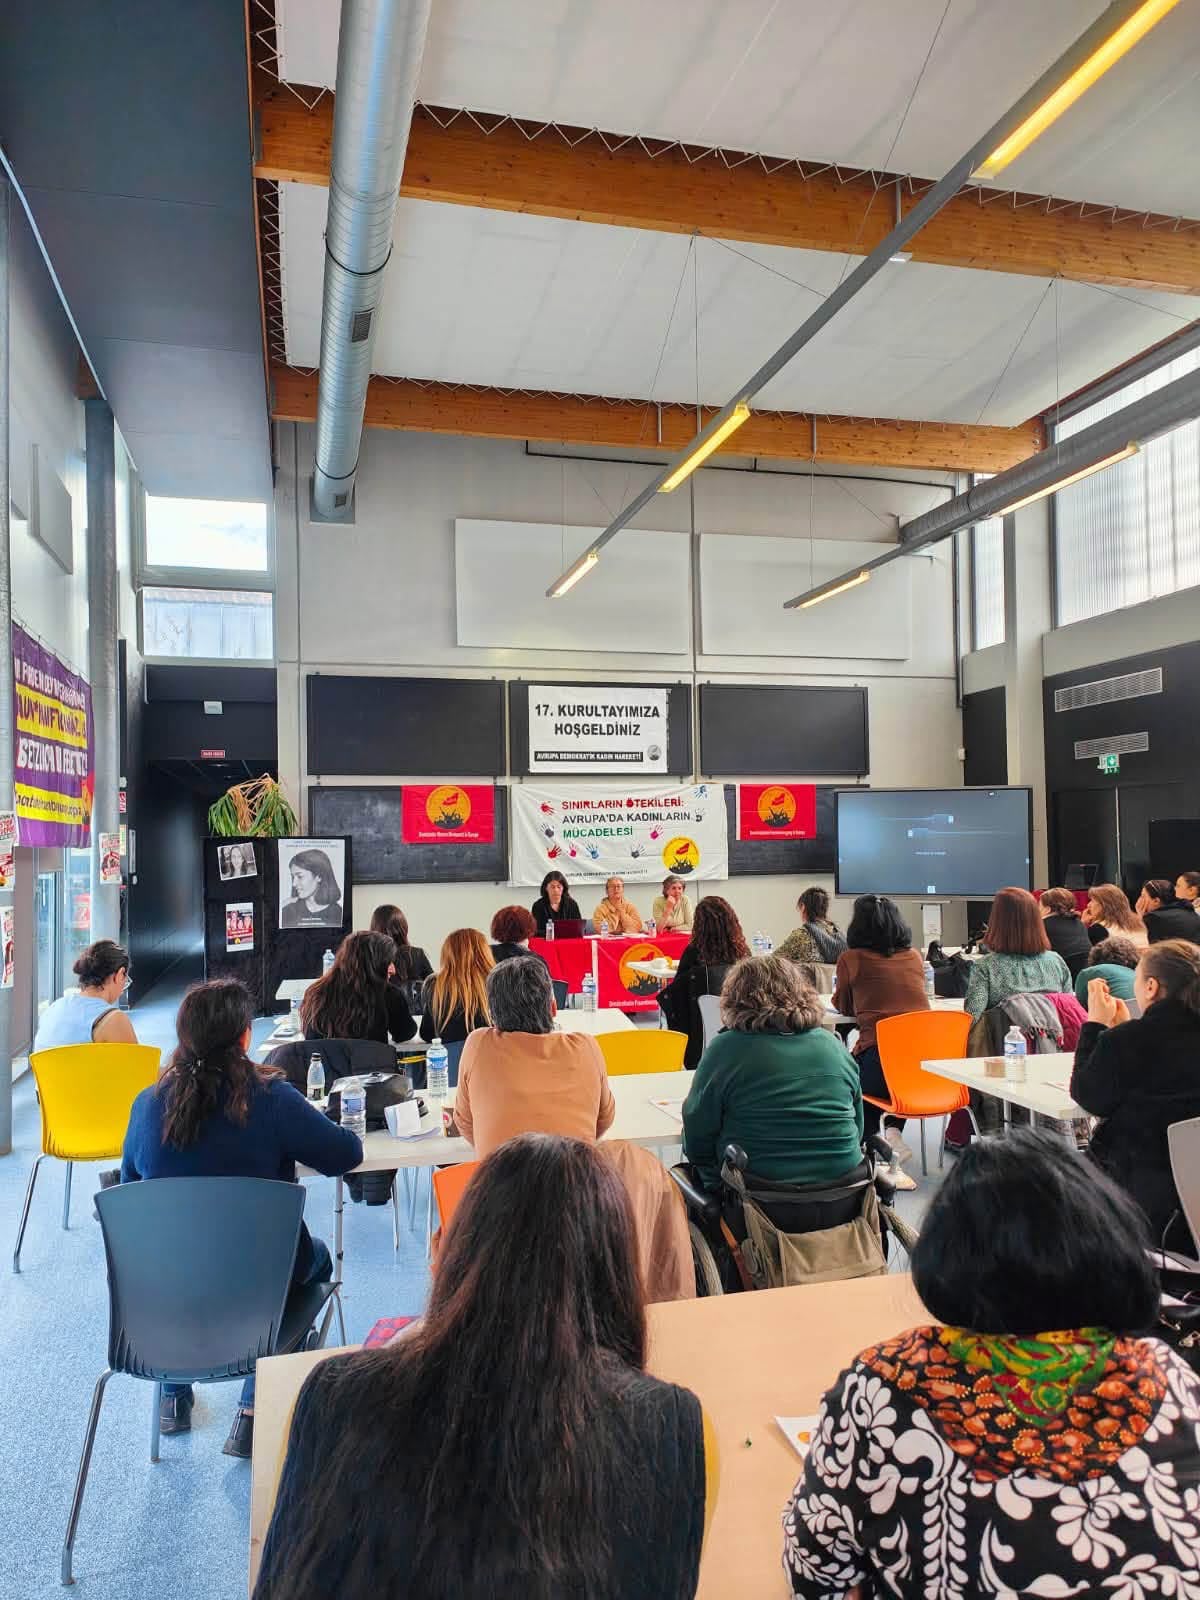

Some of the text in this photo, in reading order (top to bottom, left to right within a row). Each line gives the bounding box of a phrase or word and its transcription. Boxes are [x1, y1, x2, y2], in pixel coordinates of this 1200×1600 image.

[535, 703, 660, 718] 17. KURULTAYIMIZA
[554, 721, 641, 738] HOŞGELDİNİZ
[561, 799, 623, 811] SINIRLARIN
[562, 811, 691, 825] AVRUPA'DA KADINLARIN
[563, 825, 633, 839] MÜCADELESİ
